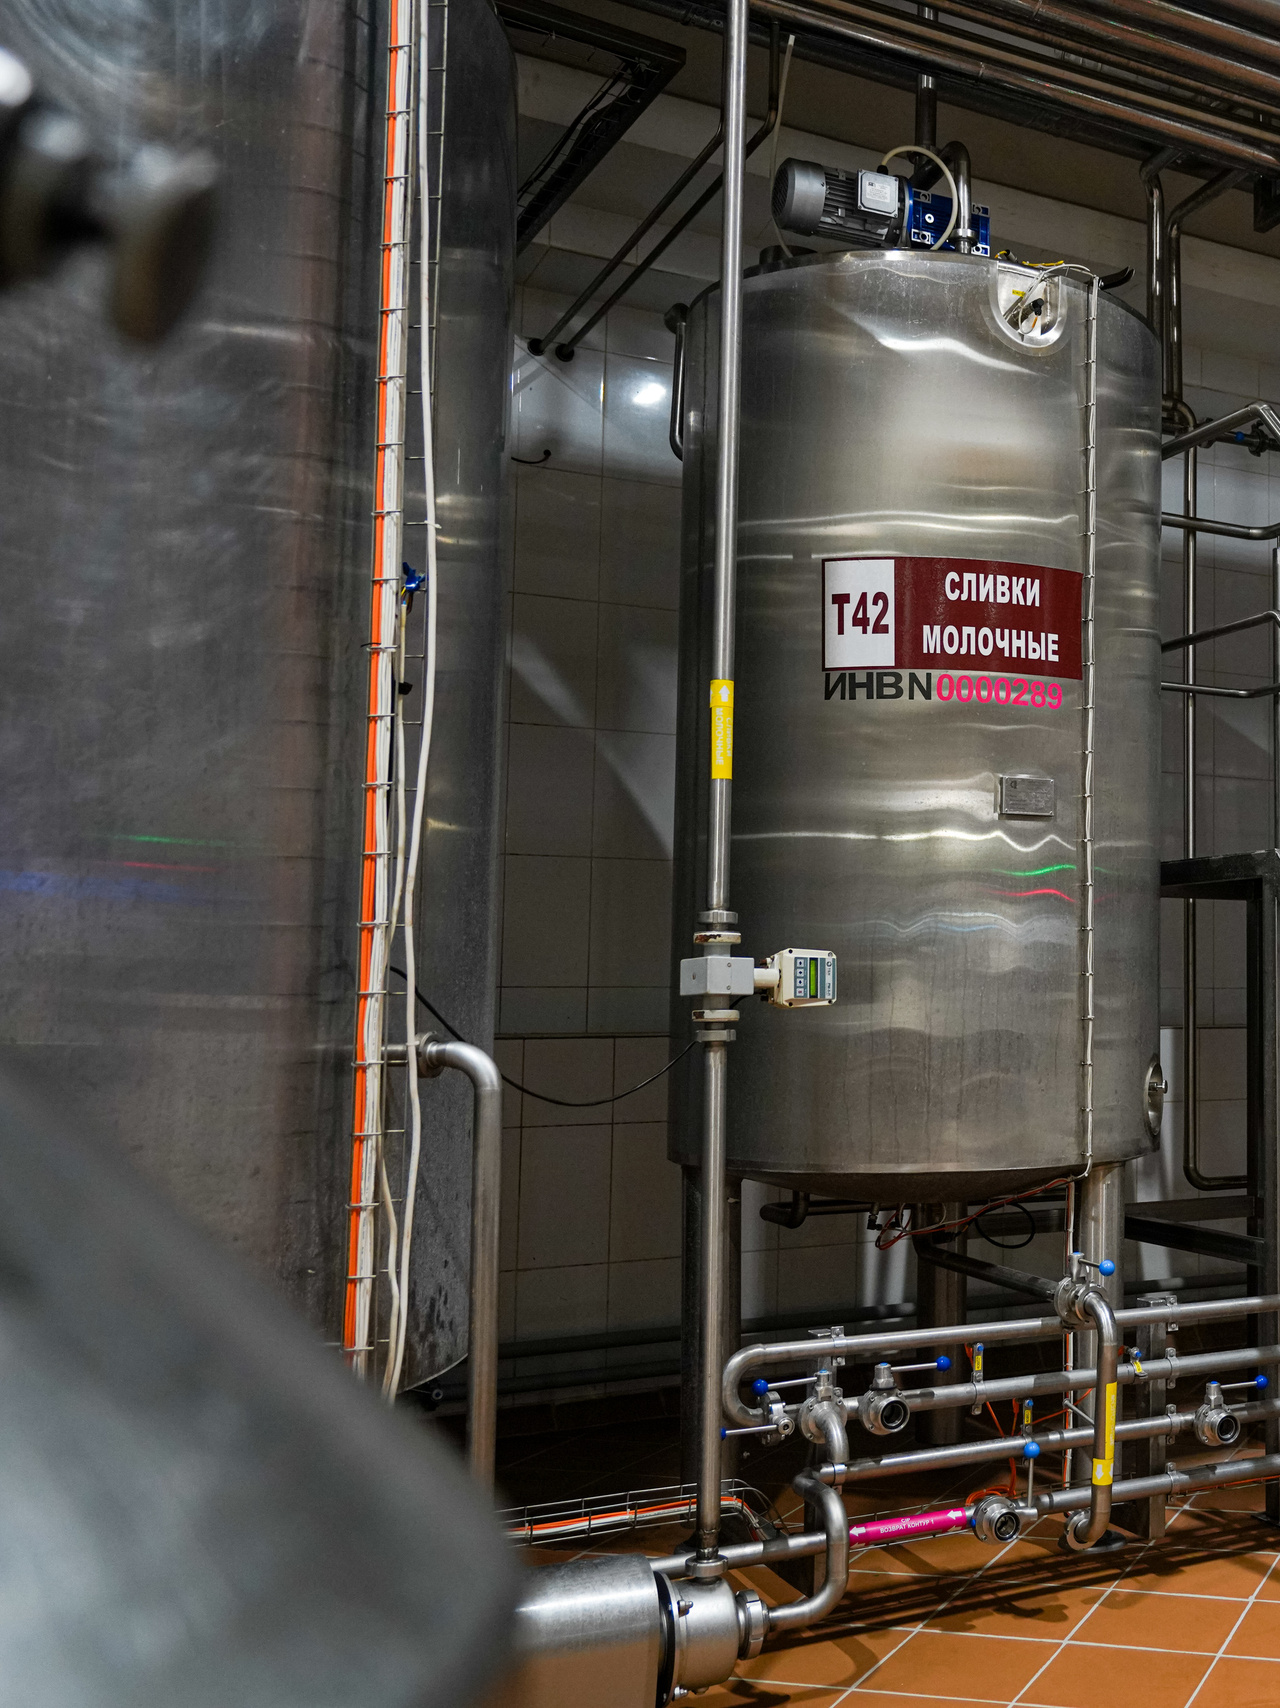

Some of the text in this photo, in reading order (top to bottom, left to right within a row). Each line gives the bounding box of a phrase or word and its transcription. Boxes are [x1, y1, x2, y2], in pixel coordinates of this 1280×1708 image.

[944, 571, 1040, 607] СЛИВКИ
[832, 591, 890, 635] Т42
[922, 624, 1060, 662] МОЛОЧНЫЕ
[715, 707, 724, 765] МОЛОЧНЫЕ
[880, 1524, 906, 1533] ВОЗВРАТ
[908, 1519, 929, 1528] КОНТУР
